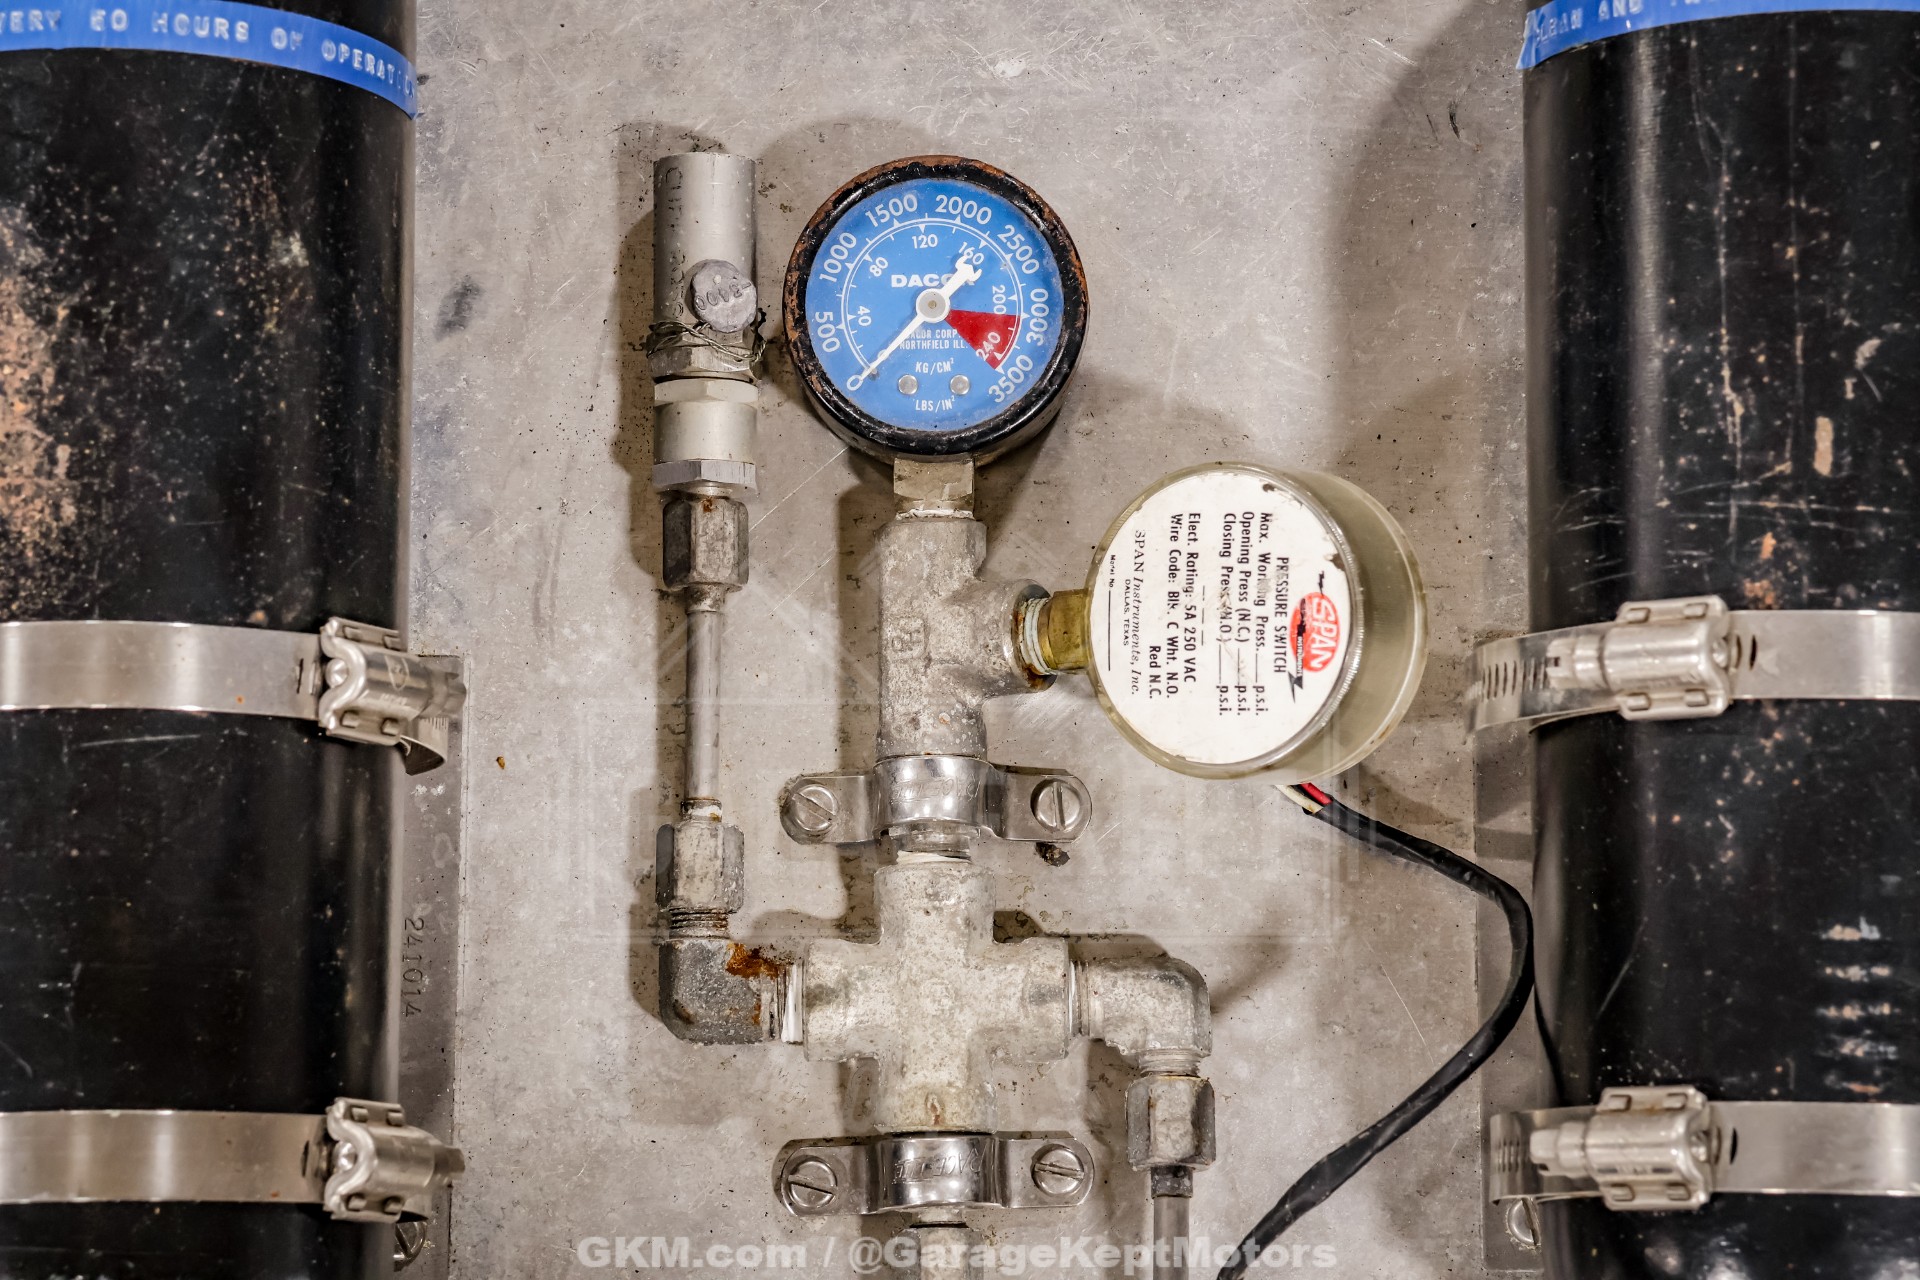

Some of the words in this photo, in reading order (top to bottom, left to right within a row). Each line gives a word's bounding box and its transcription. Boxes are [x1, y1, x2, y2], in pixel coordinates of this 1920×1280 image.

[152, 12, 250, 43] HOURS
[865, 193, 918, 228] 1500
[935, 194, 992, 225] 2000
[911, 233, 938, 249] 120
[958, 241, 985, 265] 160
[997, 225, 1040, 275] 2500
[819, 232, 857, 283] 1000
[869, 256, 889, 277] 80
[891, 273, 975, 288] DACO
[991, 285, 1007, 315] 200
[857, 305, 872, 327] 40
[1026, 288, 1049, 347] 3000
[814, 311, 841, 353] 500
[900, 339, 949, 350] NORTHFIELD
[935, 329, 961, 339] CORP.
[975, 331, 1001, 361] 240
[988, 354, 1034, 404] 3500
[1170, 514, 1183, 542] Wire
[1186, 513, 1201, 546] Elect.
[1218, 513, 1236, 558] Closing
[1237, 512, 1255, 564] Opening
[1258, 512, 1273, 543] Max.
[1133, 530, 1146, 573] SPAN
[1168, 549, 1182, 583] Code:
[1182, 552, 1199, 598] Rating:
[1238, 570, 1251, 602] Press
[1253, 552, 1271, 607] Worng
[1274, 557, 1289, 618] PRESSURE
[1166, 591, 1179, 615] Blk.
[1184, 604, 1197, 620] 5A
[1130, 577, 1144, 666] Instruments,
[1167, 621, 1179, 629] C
[1234, 608, 1251, 643] (N.C.)
[1255, 616, 1268, 651] Press.
[1309, 597, 1337, 669] SPAN
[1166, 636, 1179, 665] Wht.
[1184, 627, 1196, 651] 250
[1273, 626, 1287, 673] SWITCH
[1149, 645, 1161, 668] Red
[1183, 657, 1196, 683] VAC
[1131, 669, 1141, 695] Inc.
[1149, 675, 1161, 699] N.C.
[1166, 672, 1178, 698] N.O.
[1216, 685, 1232, 716] p.s.i.
[1234, 685, 1250, 716] p.s.i.
[1252, 685, 1268, 716] p.s.i.
